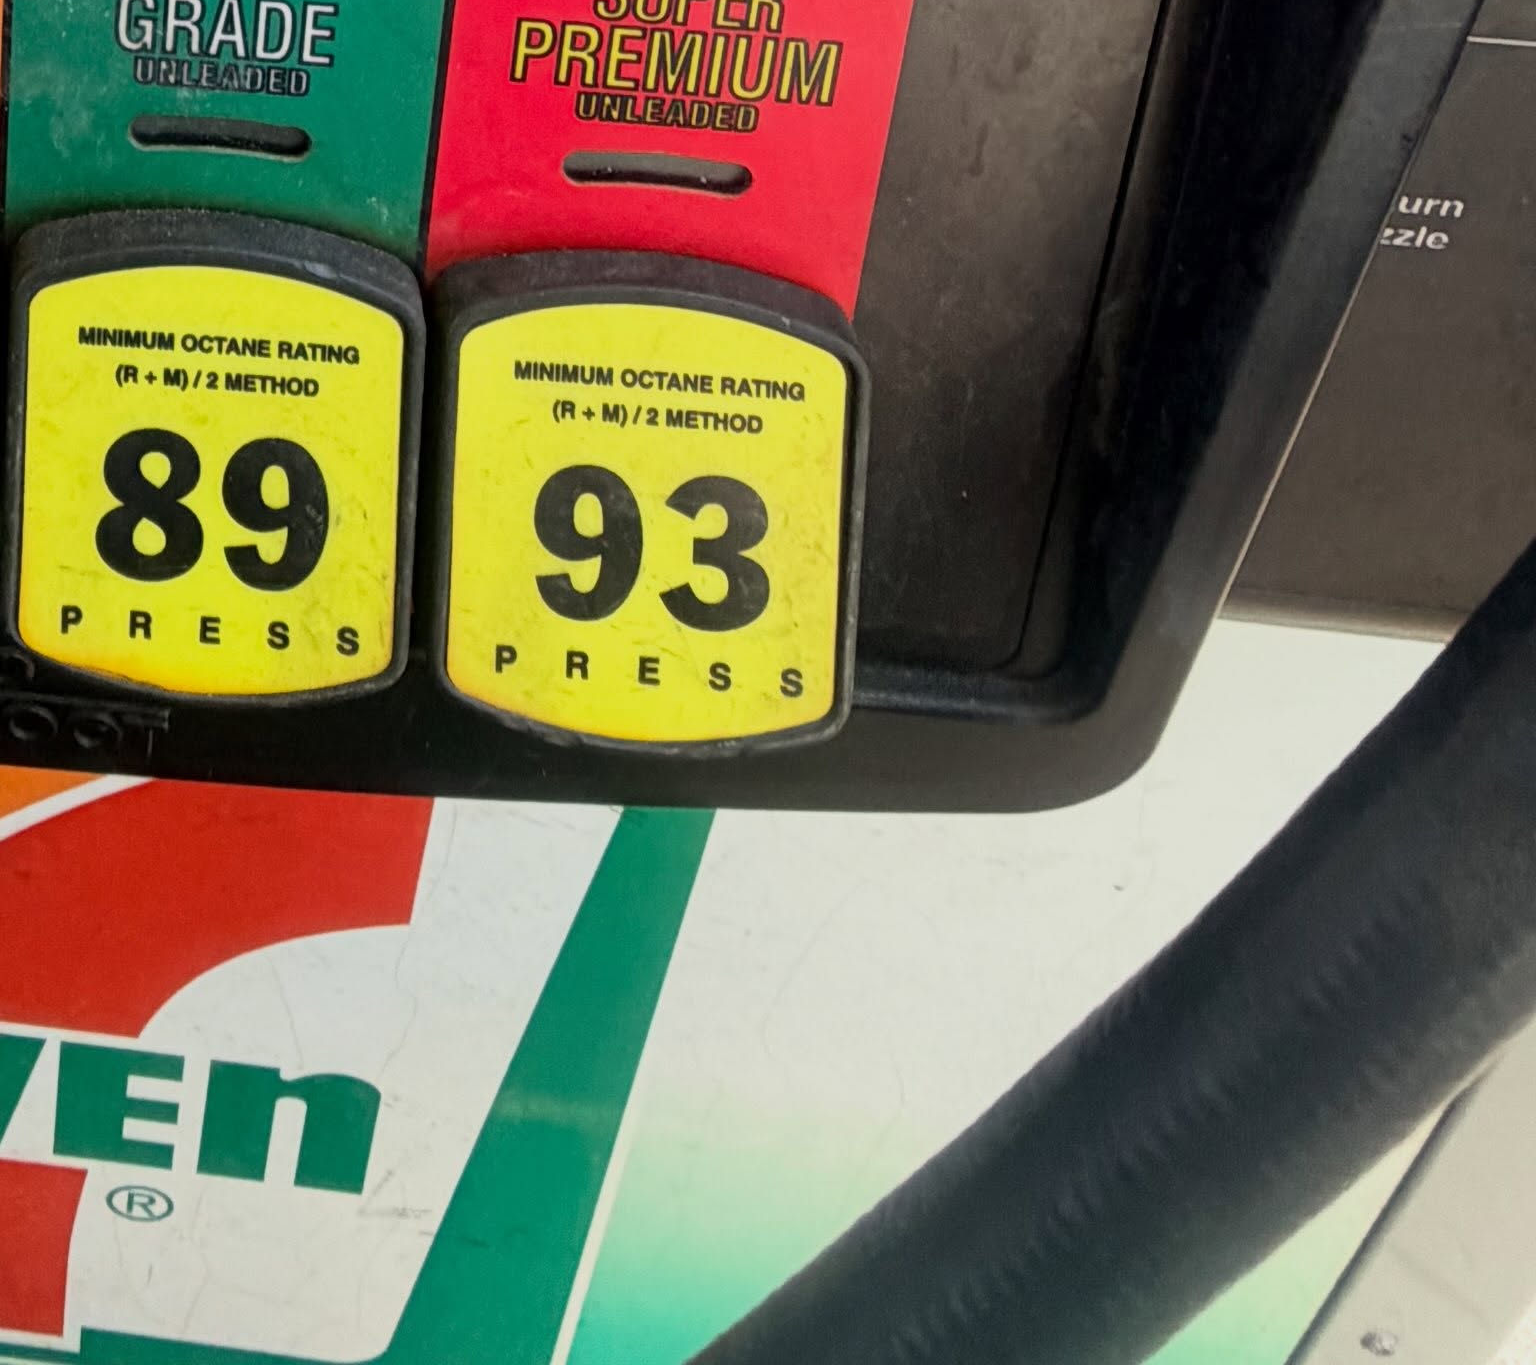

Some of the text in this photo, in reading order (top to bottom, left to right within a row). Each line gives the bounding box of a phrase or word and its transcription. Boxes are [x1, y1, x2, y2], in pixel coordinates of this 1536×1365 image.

[133, 54, 311, 98] UNLEADED
[509, 17, 843, 107] PREMIUM
[574, 90, 759, 135] UNLEADED
[78, 325, 360, 365] MINIMUM OCTANE RATING
[206, 371, 219, 390] 2
[224, 373, 319, 398] METHOD
[513, 360, 806, 402] MINIMUM OCTANE RATING
[646, 406, 659, 426] 2
[665, 409, 764, 434] METHOD
[95, 427, 329, 593] 89
[534, 464, 771, 633] 93
[60, 604, 361, 657] PRESS
[495, 643, 804, 699] PRESS
